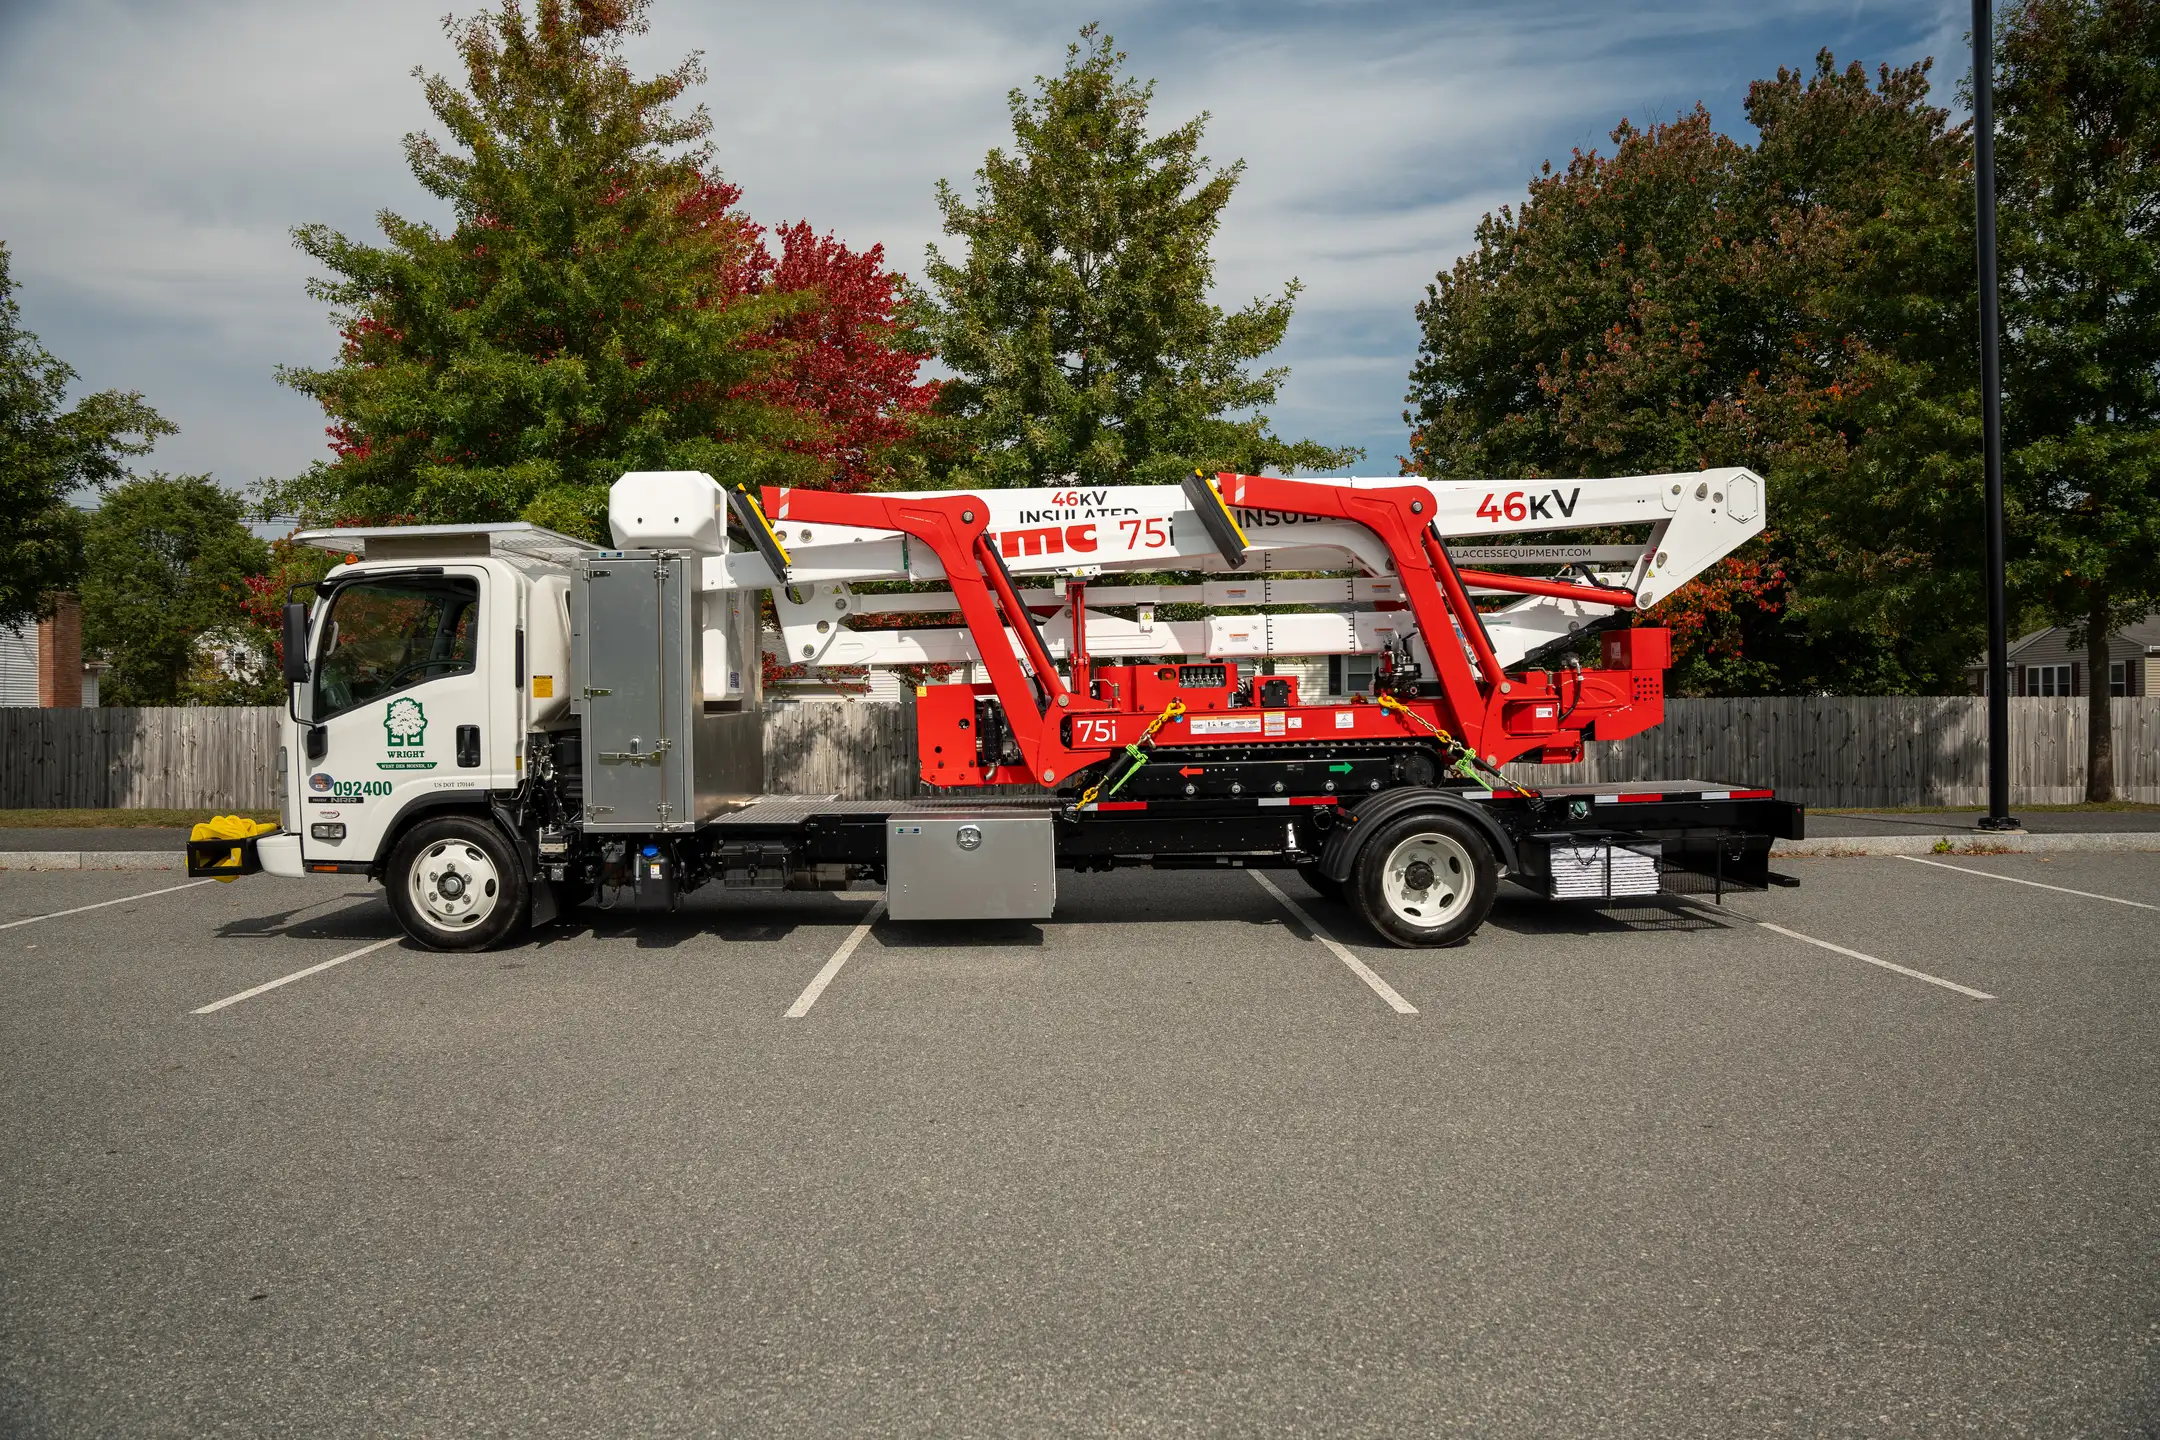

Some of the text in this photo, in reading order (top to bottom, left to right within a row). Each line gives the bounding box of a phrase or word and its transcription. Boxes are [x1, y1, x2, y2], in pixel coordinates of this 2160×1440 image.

[1236, 509, 1337, 529] INSUL
[989, 524, 1098, 559] mc
[1119, 517, 1175, 550] 75i
[1077, 719, 1116, 743] 75i
[387, 750, 425, 758] WRIGHT
[333, 781, 392, 796] 092400
